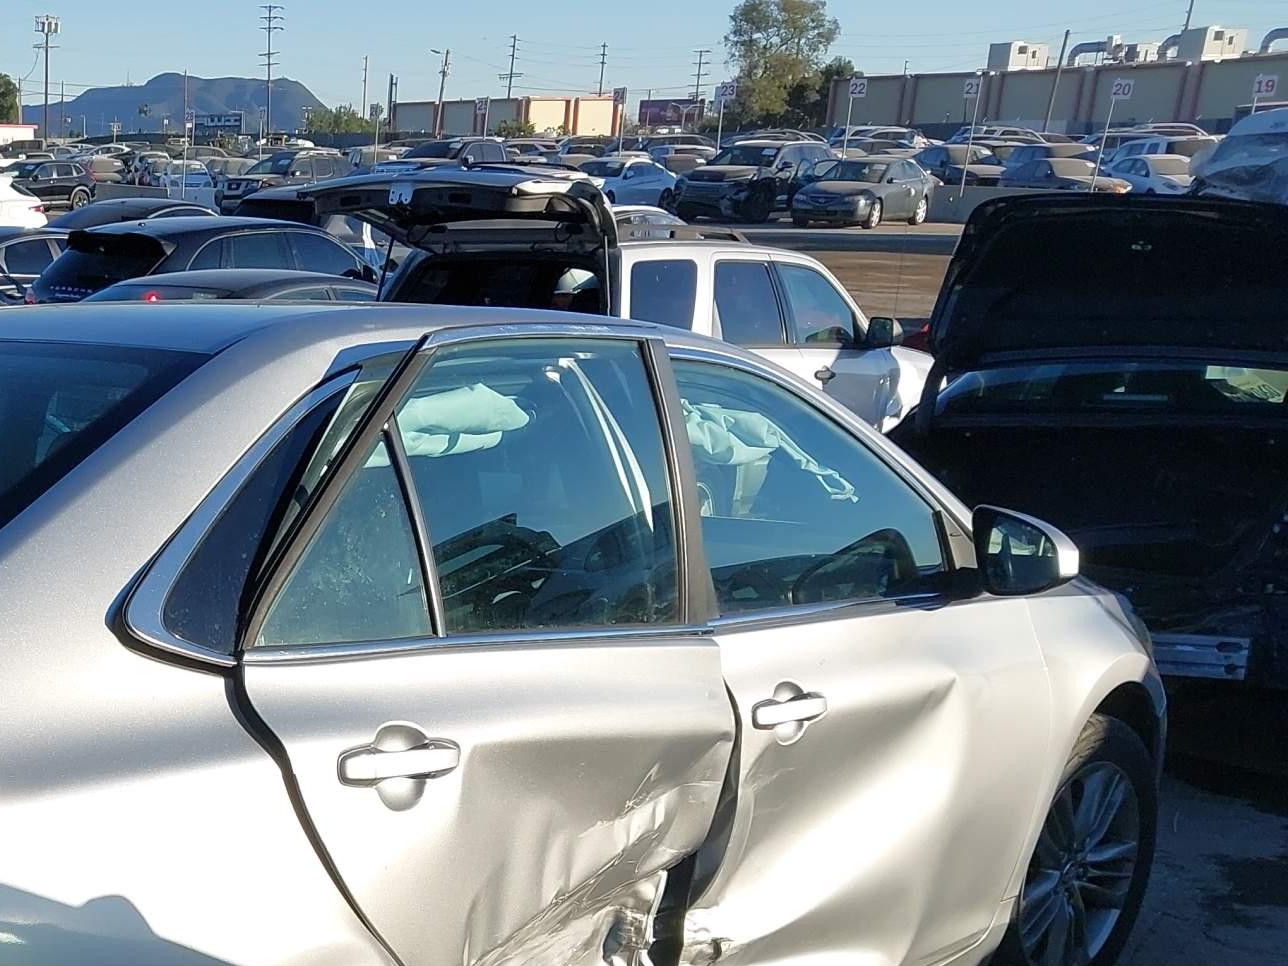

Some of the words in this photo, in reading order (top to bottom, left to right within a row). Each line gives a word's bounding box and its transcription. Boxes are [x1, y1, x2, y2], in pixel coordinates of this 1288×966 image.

[720, 85, 736, 97] 23
[850, 82, 866, 95] 22
[1112, 82, 1132, 96] 20
[1255, 79, 1276, 94] 19
